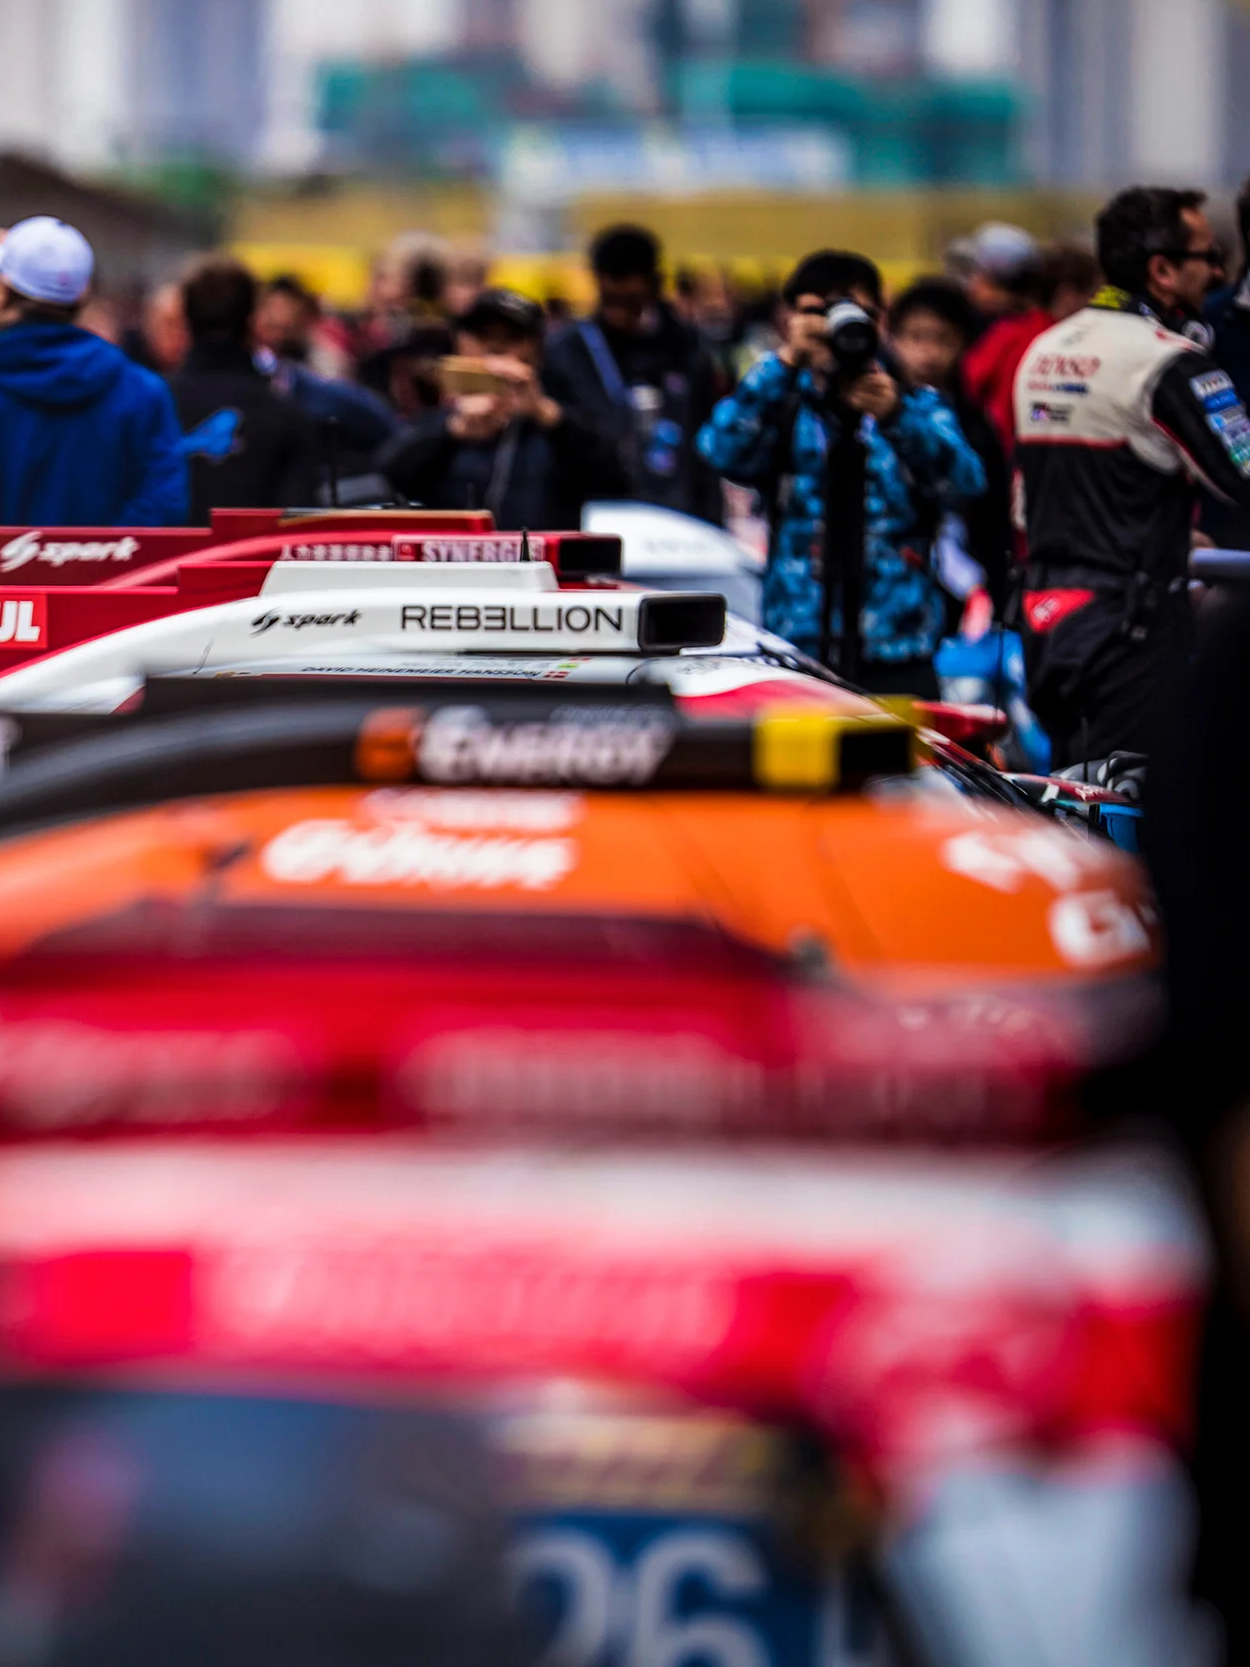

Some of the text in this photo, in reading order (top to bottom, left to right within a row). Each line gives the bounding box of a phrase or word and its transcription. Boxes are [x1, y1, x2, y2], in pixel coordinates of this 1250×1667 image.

[39, 536, 140, 566] spark
[283, 608, 363, 631] spark
[400, 605, 624, 633] REBELLION
